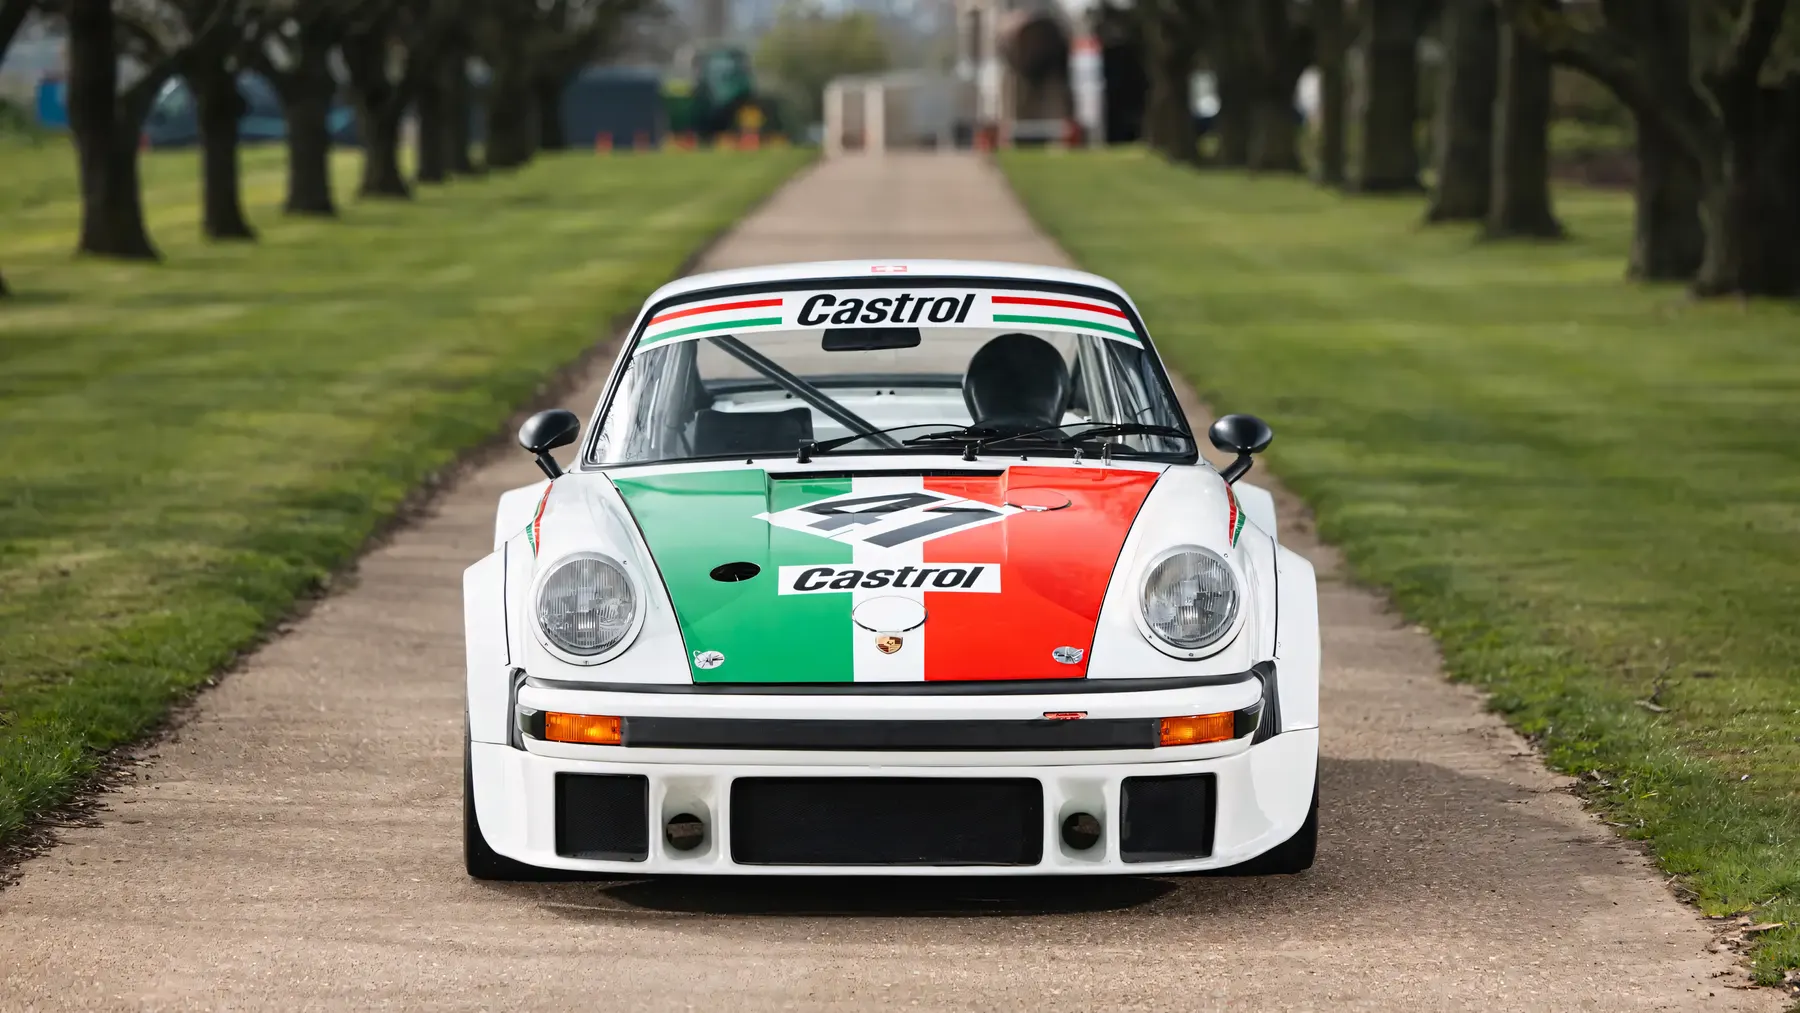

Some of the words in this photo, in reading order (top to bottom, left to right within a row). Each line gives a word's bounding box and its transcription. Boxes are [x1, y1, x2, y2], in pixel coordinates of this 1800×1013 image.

[797, 293, 975, 326] Castrol
[797, 492, 1004, 549] 41
[793, 566, 985, 592] Castrol
